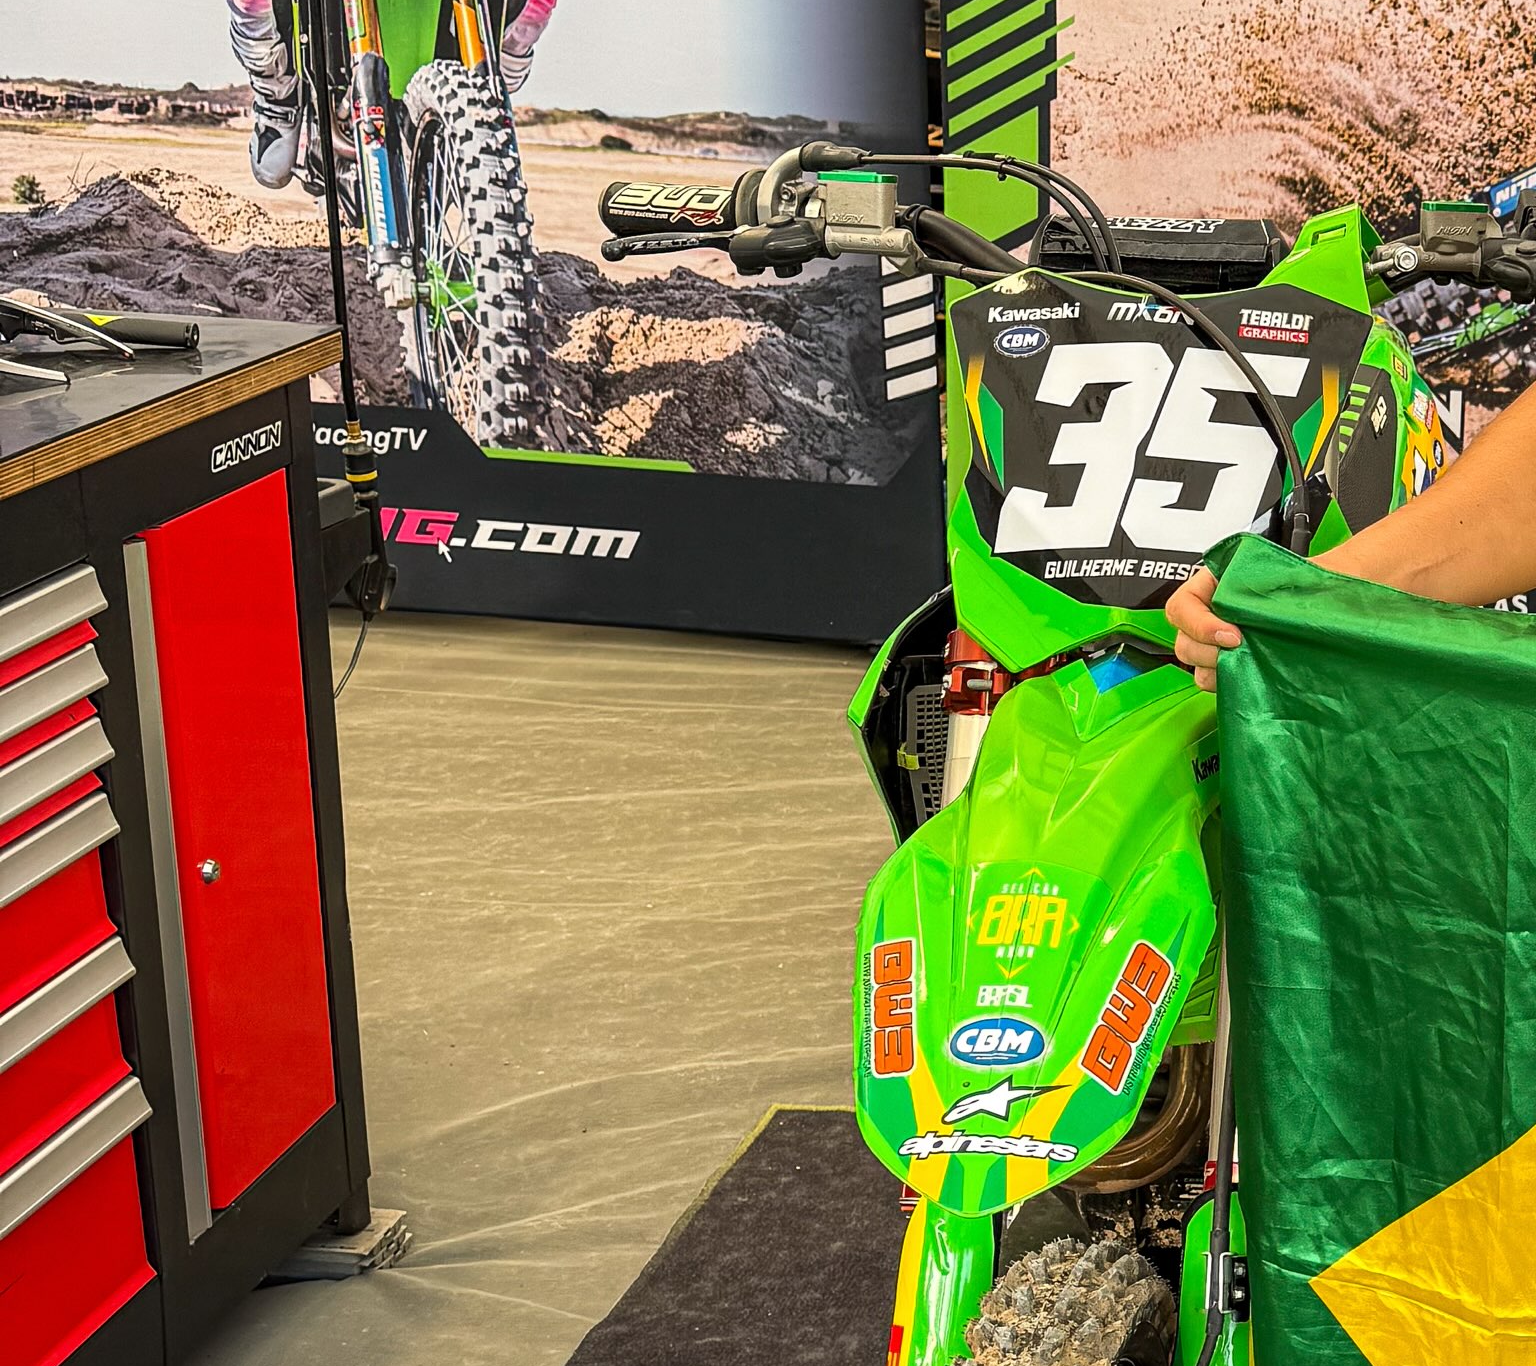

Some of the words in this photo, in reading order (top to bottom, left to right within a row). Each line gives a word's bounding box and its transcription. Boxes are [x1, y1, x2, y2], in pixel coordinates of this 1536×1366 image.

[987, 302, 1081, 324] Kawasaki
[1238, 309, 1314, 331] TEBALDI
[1001, 332, 1040, 349] CBM
[1243, 327, 1306, 344] GRAPHICS
[211, 421, 282, 473] CANNON
[993, 342, 1310, 553] 35
[1044, 560, 1135, 580] GUILHERME
[976, 894, 1068, 948] BRA
[955, 1027, 1035, 1055] CBM
[898, 1129, 1079, 1162] alpinestars
